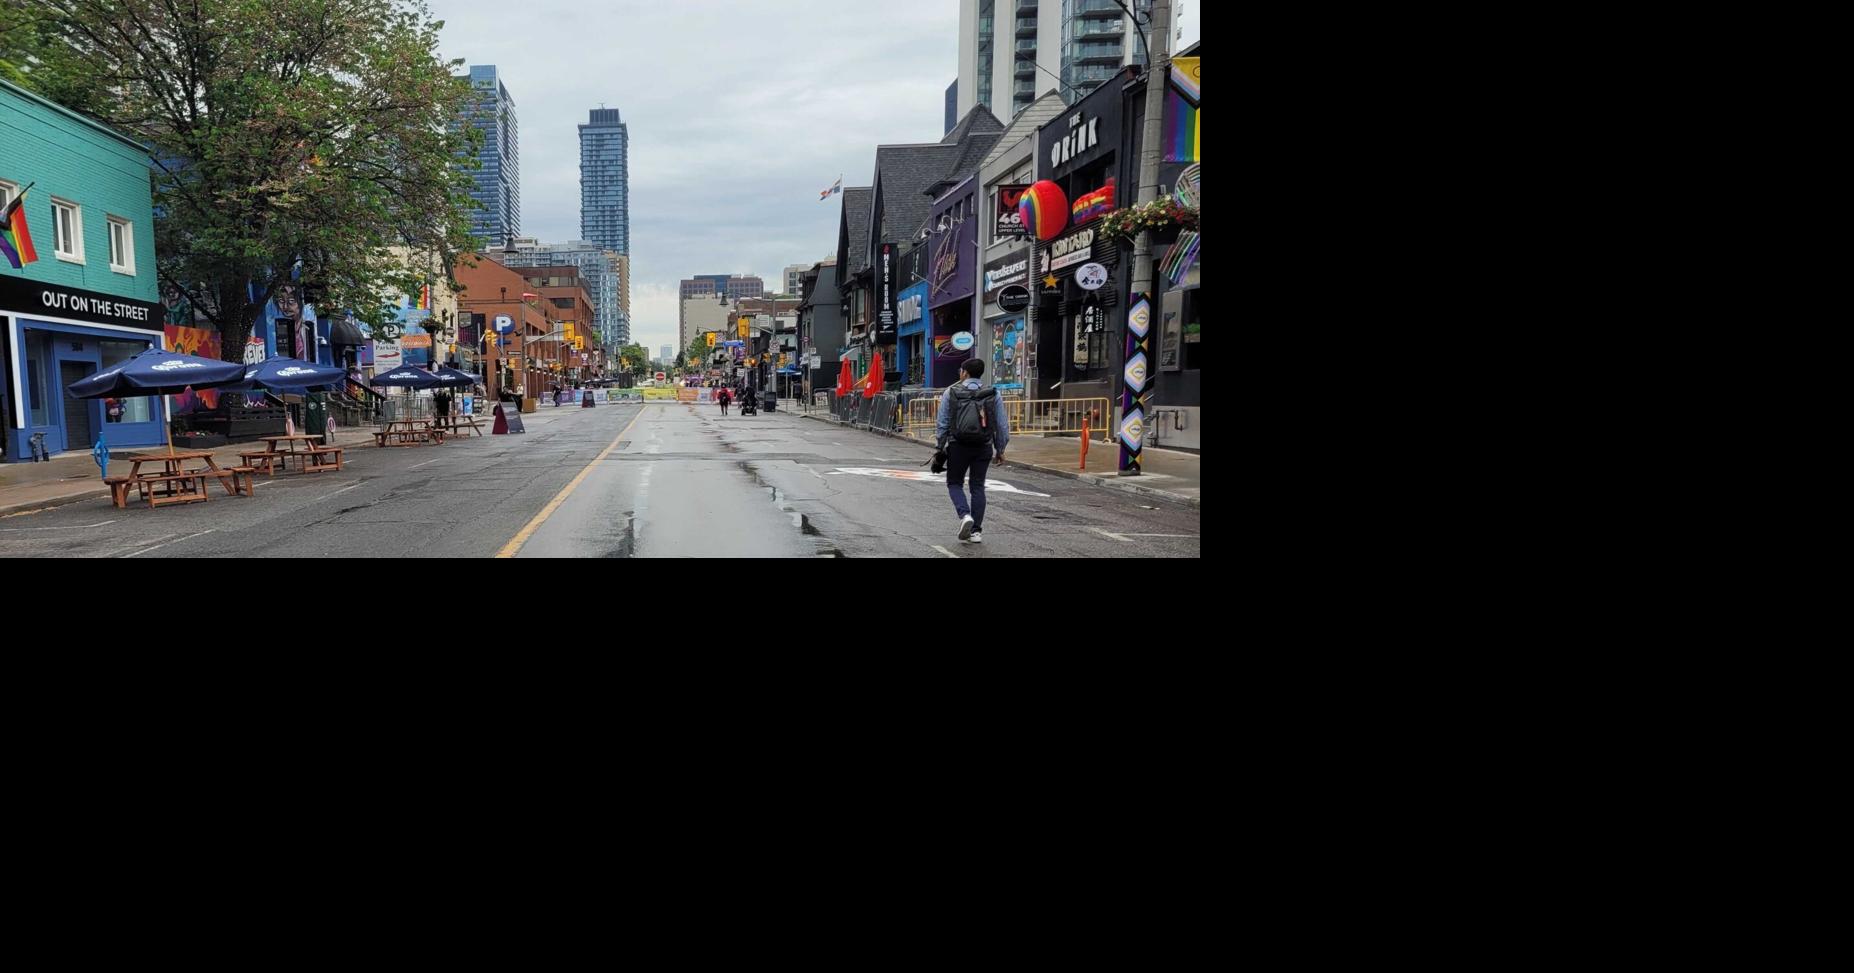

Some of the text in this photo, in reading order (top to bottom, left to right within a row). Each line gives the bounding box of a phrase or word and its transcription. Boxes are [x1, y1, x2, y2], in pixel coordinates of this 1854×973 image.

[1069, 111, 1081, 128] THE
[998, 212, 1022, 224] 46
[42, 290, 149, 321] OUT ON THE STREET
[496, 316, 510, 331] P
